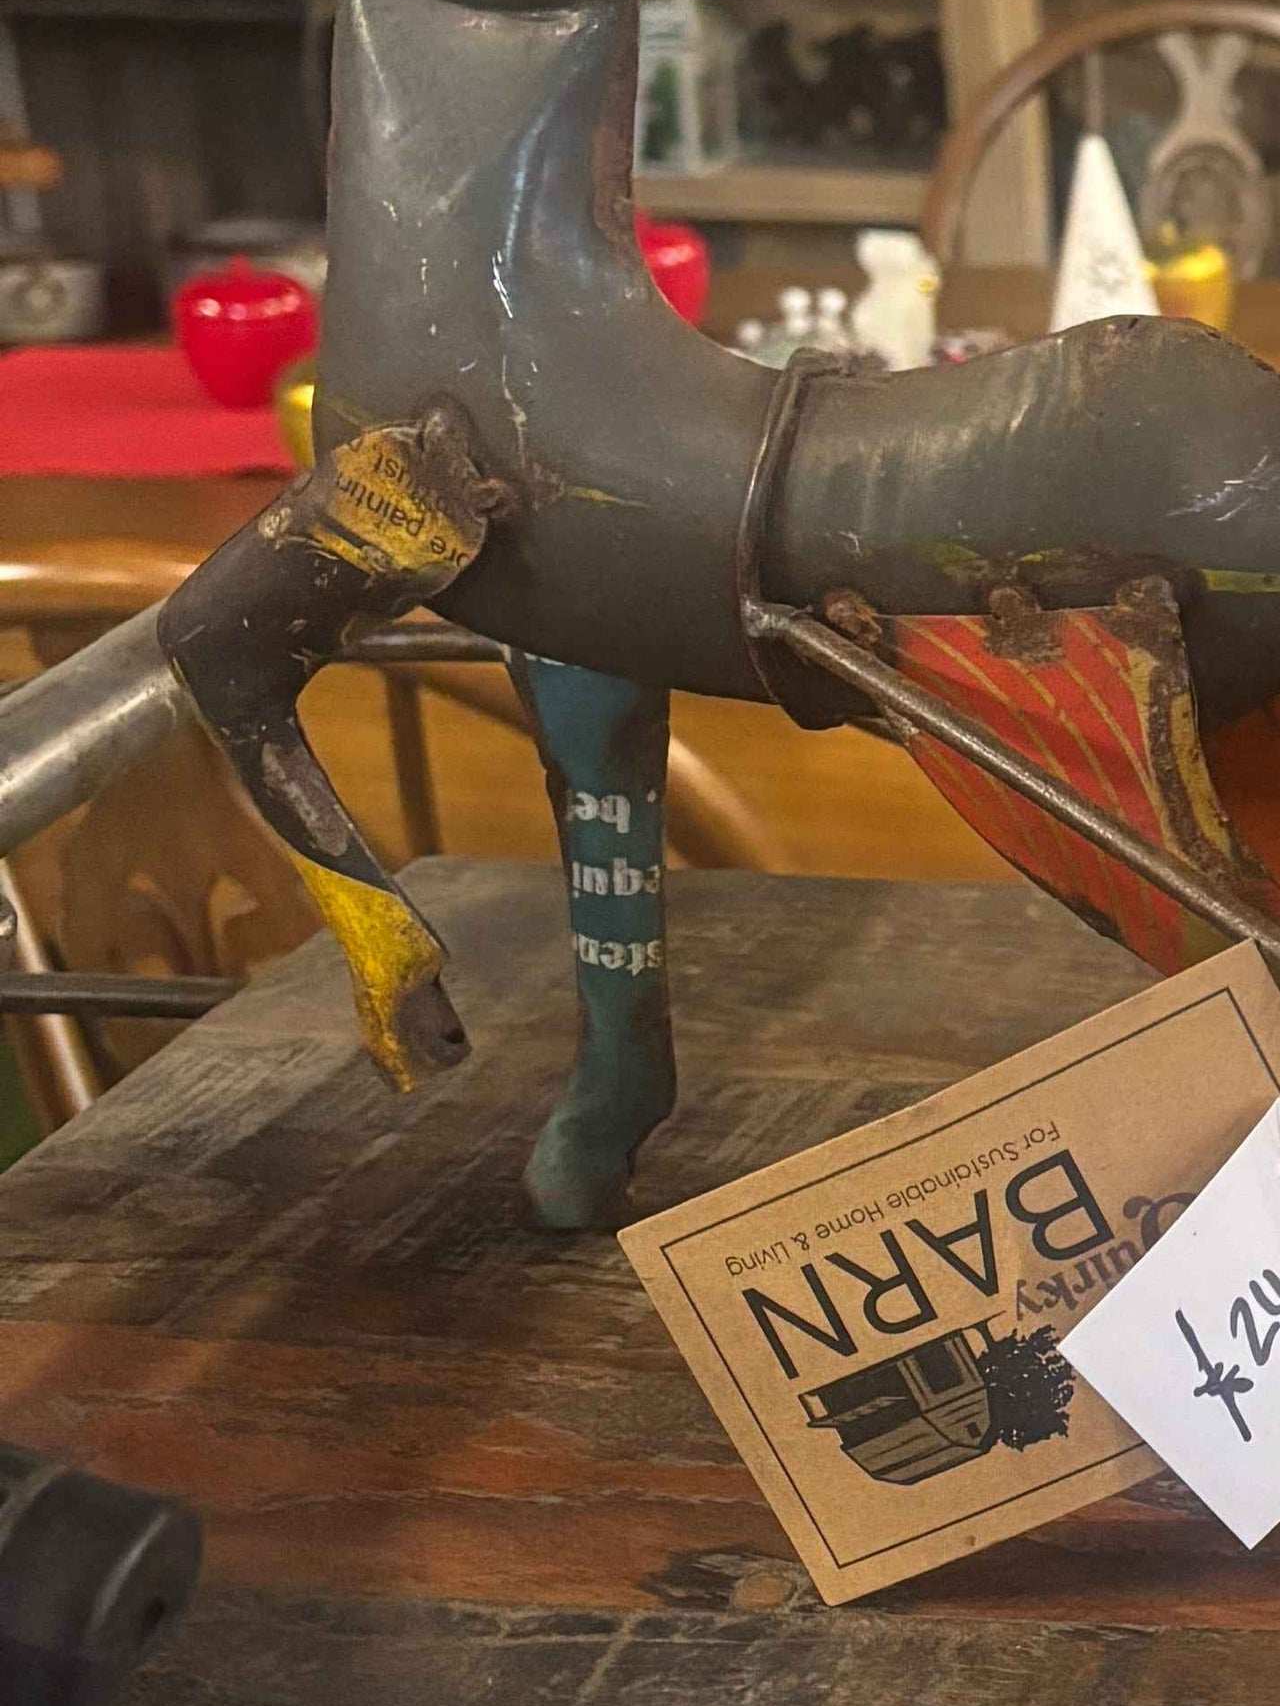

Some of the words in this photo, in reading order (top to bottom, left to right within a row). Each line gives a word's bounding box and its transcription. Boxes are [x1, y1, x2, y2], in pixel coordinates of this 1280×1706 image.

[1023, 1121, 1061, 1150] For
[886, 1142, 1019, 1210] Sustainable
[815, 1200, 884, 1240] Home
[725, 1241, 791, 1277] Living
[790, 1230, 811, 1251] &
[742, 1149, 1115, 1380] BARN
